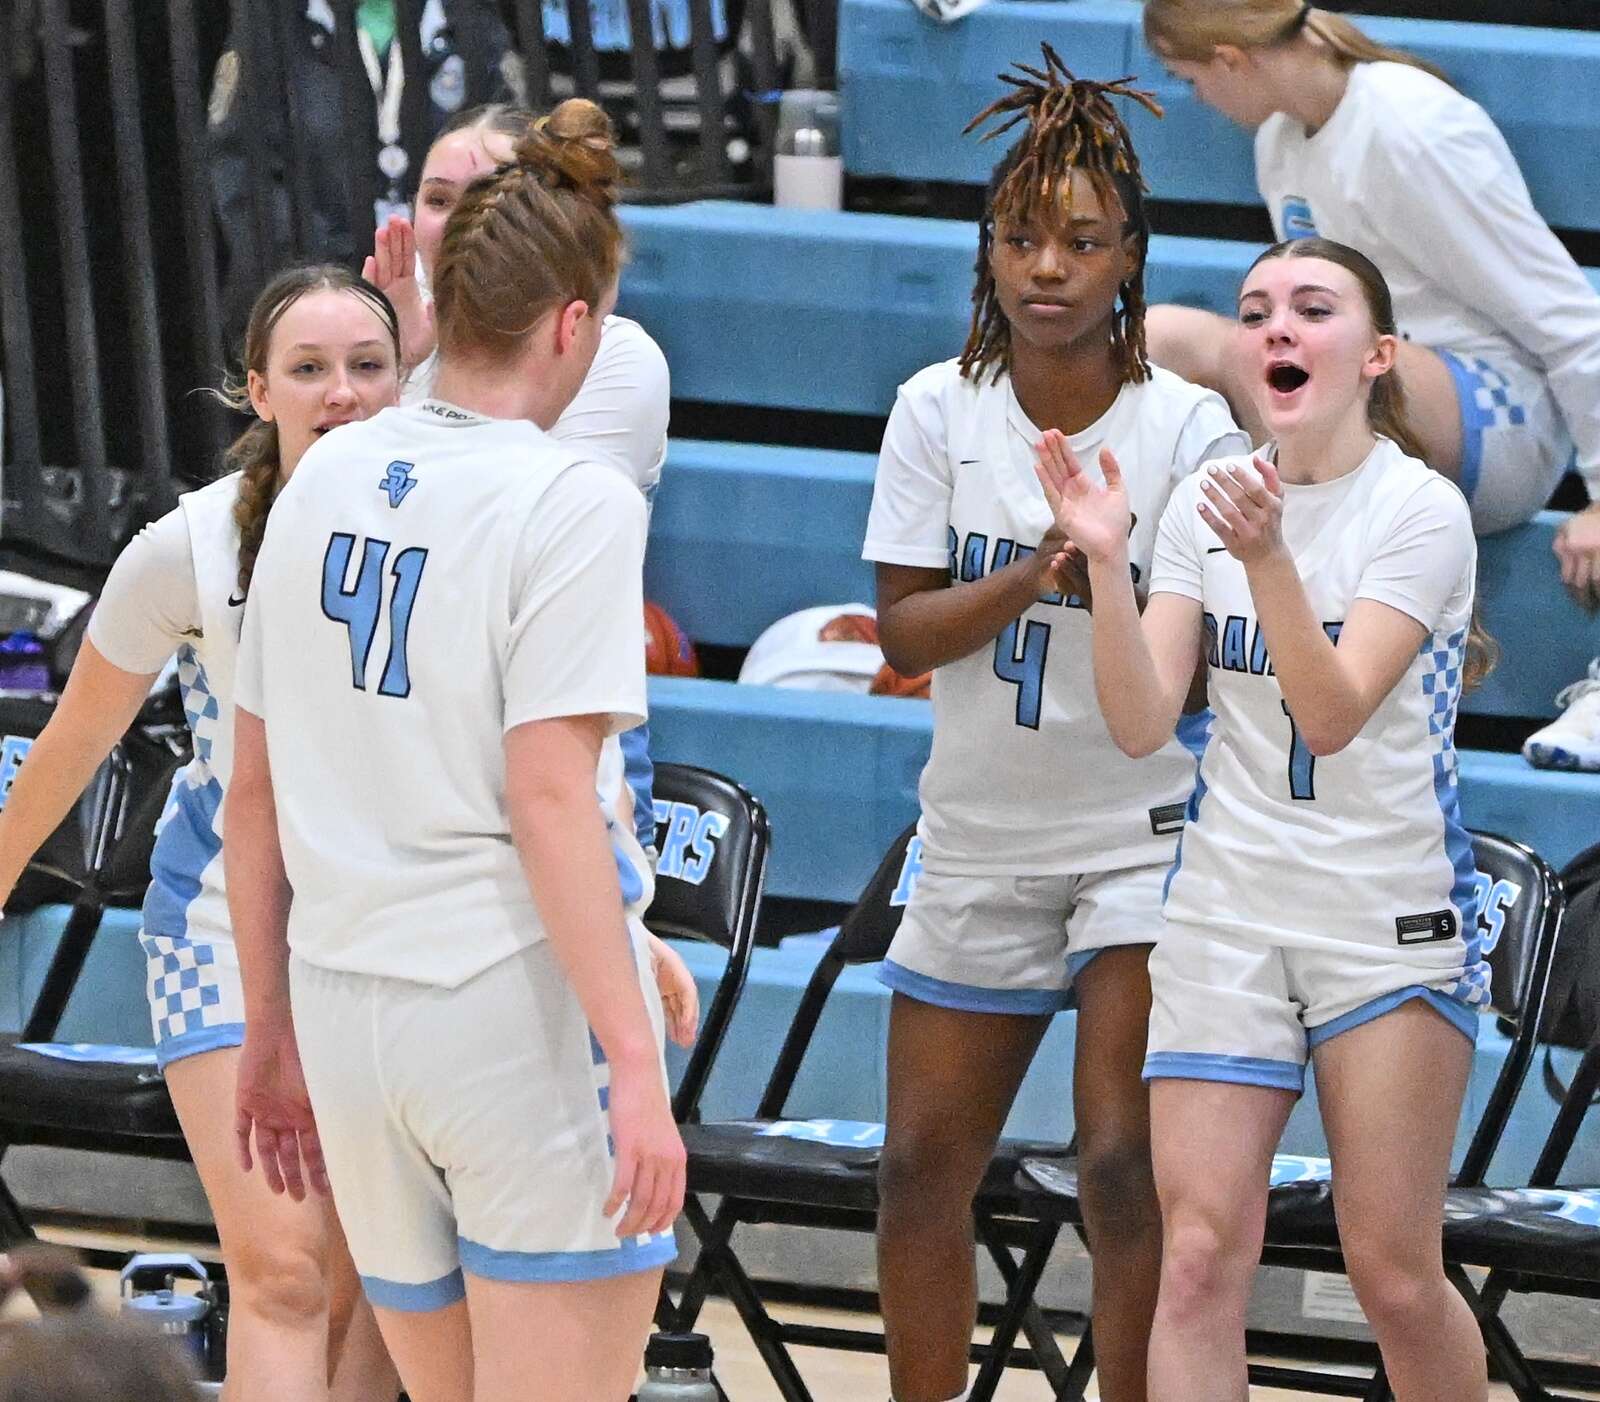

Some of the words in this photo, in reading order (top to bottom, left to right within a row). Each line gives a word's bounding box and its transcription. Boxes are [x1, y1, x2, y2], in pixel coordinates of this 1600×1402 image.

[320, 531, 429, 699] 41
[992, 618, 1052, 731] 4
[1440, 919, 1450, 931] S
